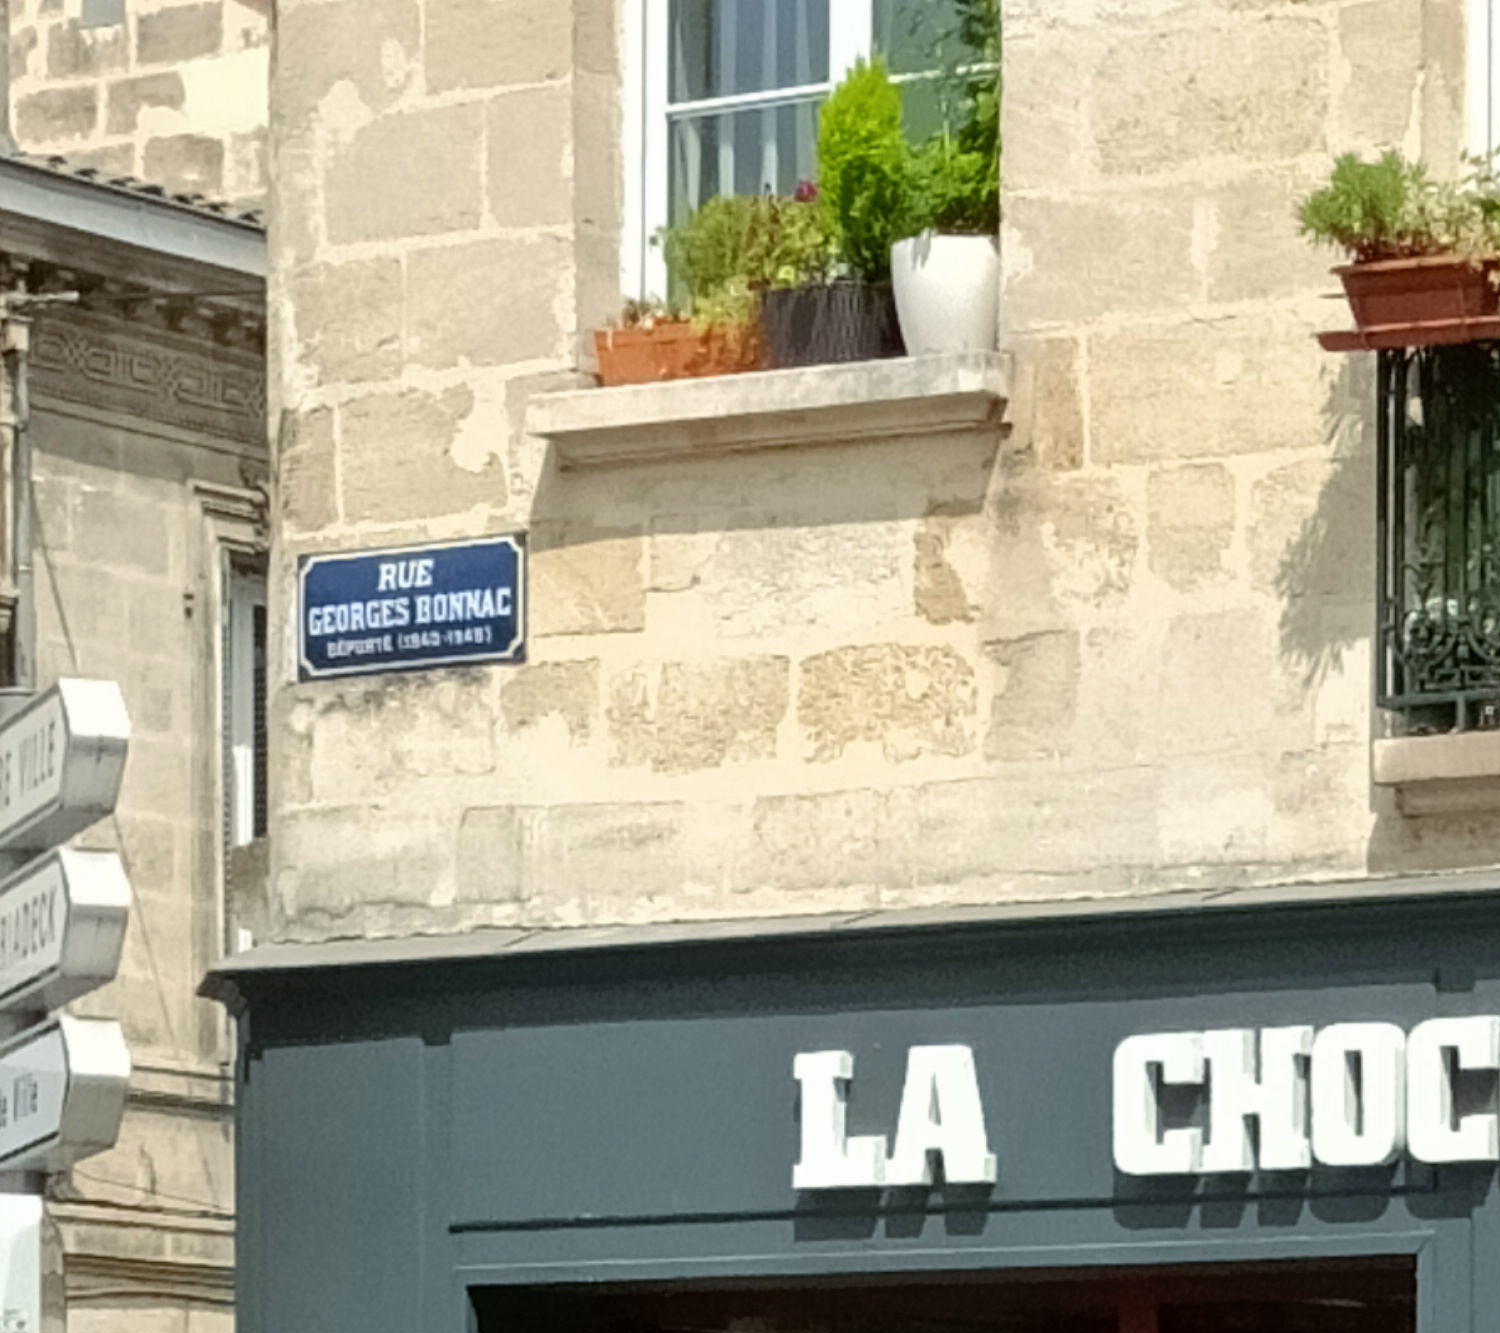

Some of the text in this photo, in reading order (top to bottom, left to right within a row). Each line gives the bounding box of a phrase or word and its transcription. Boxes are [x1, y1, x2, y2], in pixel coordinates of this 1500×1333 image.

[377, 558, 435, 592] RUE
[307, 586, 513, 637] GEORGES BONNAC
[792, 1044, 998, 1189] LA
